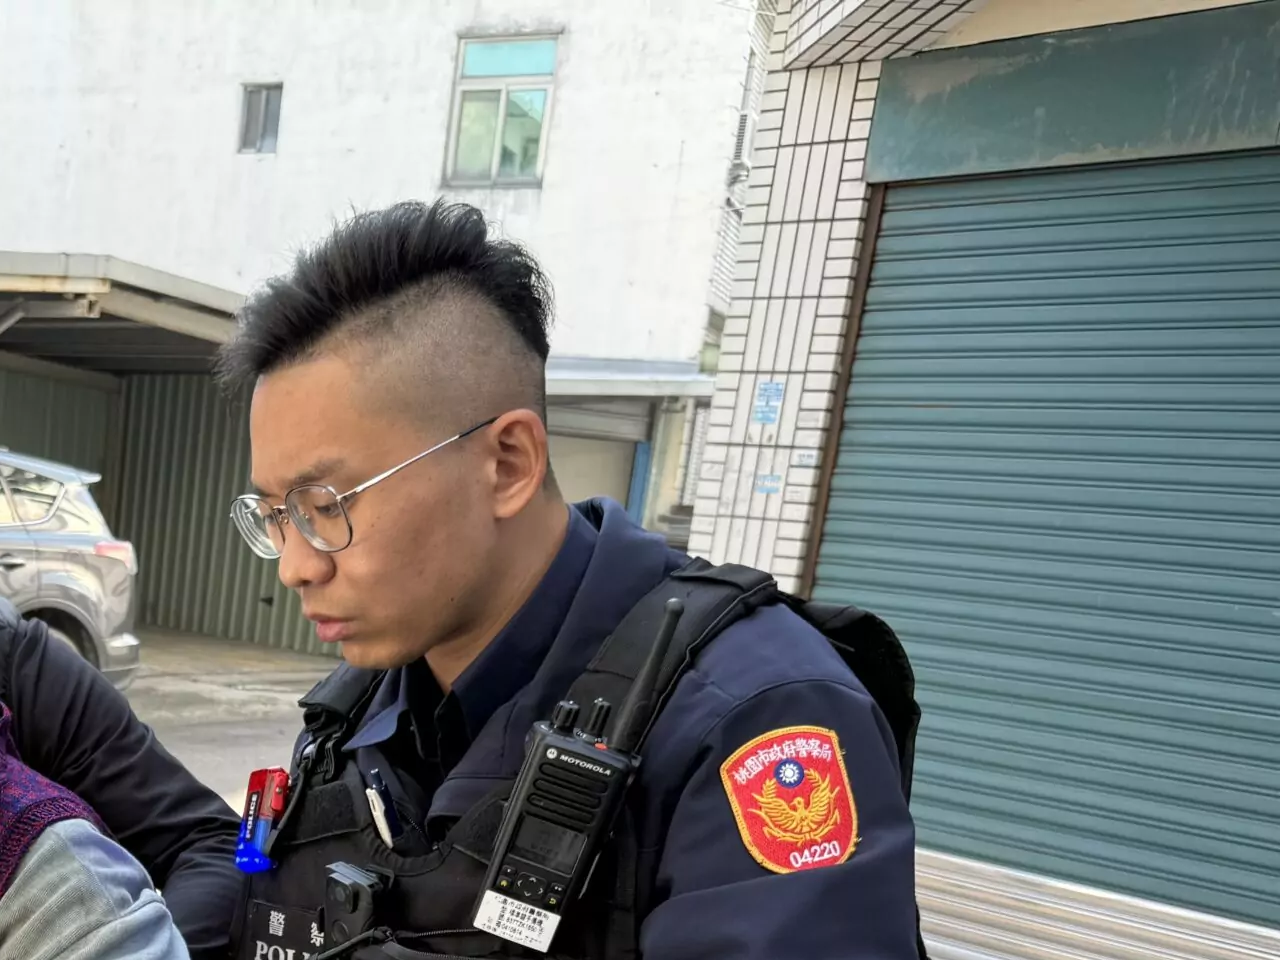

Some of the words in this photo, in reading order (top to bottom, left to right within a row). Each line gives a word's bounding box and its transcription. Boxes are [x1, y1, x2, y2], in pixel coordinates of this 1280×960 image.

[560, 754, 611, 776] MOTOROLA
[732, 738, 832, 785] 桃園市政府警察局
[245, 793, 259, 839] POLICE
[789, 841, 840, 868] 04220
